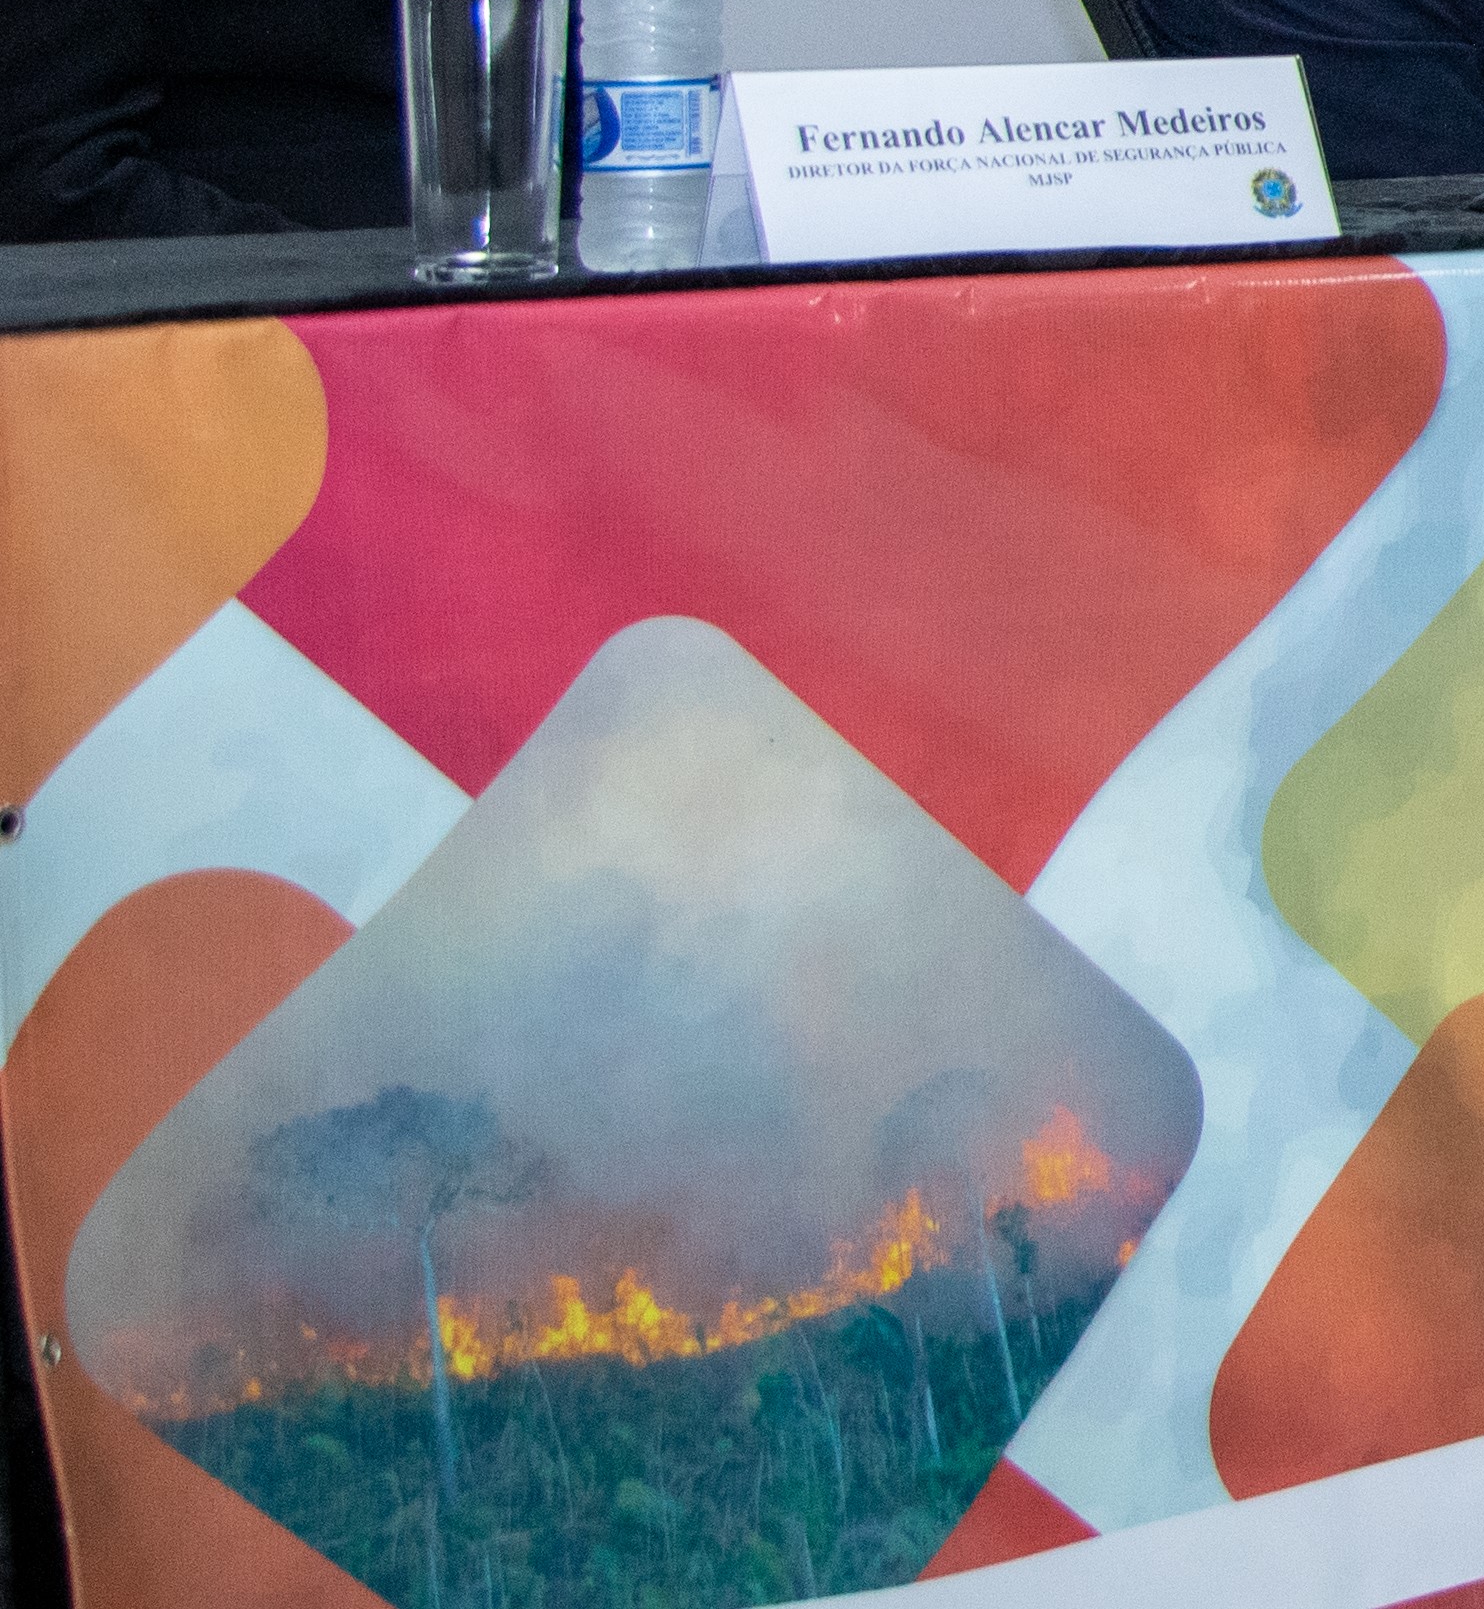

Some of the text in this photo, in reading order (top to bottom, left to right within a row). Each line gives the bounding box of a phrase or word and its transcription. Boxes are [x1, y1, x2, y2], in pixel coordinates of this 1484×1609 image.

[797, 106, 1267, 153] Fernando Alencar Medeiros
[788, 139, 1288, 179] DIRETOR DA FORÇA NACIONAL DE SEGURANÇA PÚBLICA
[1028, 172, 1073, 187] MJSP
